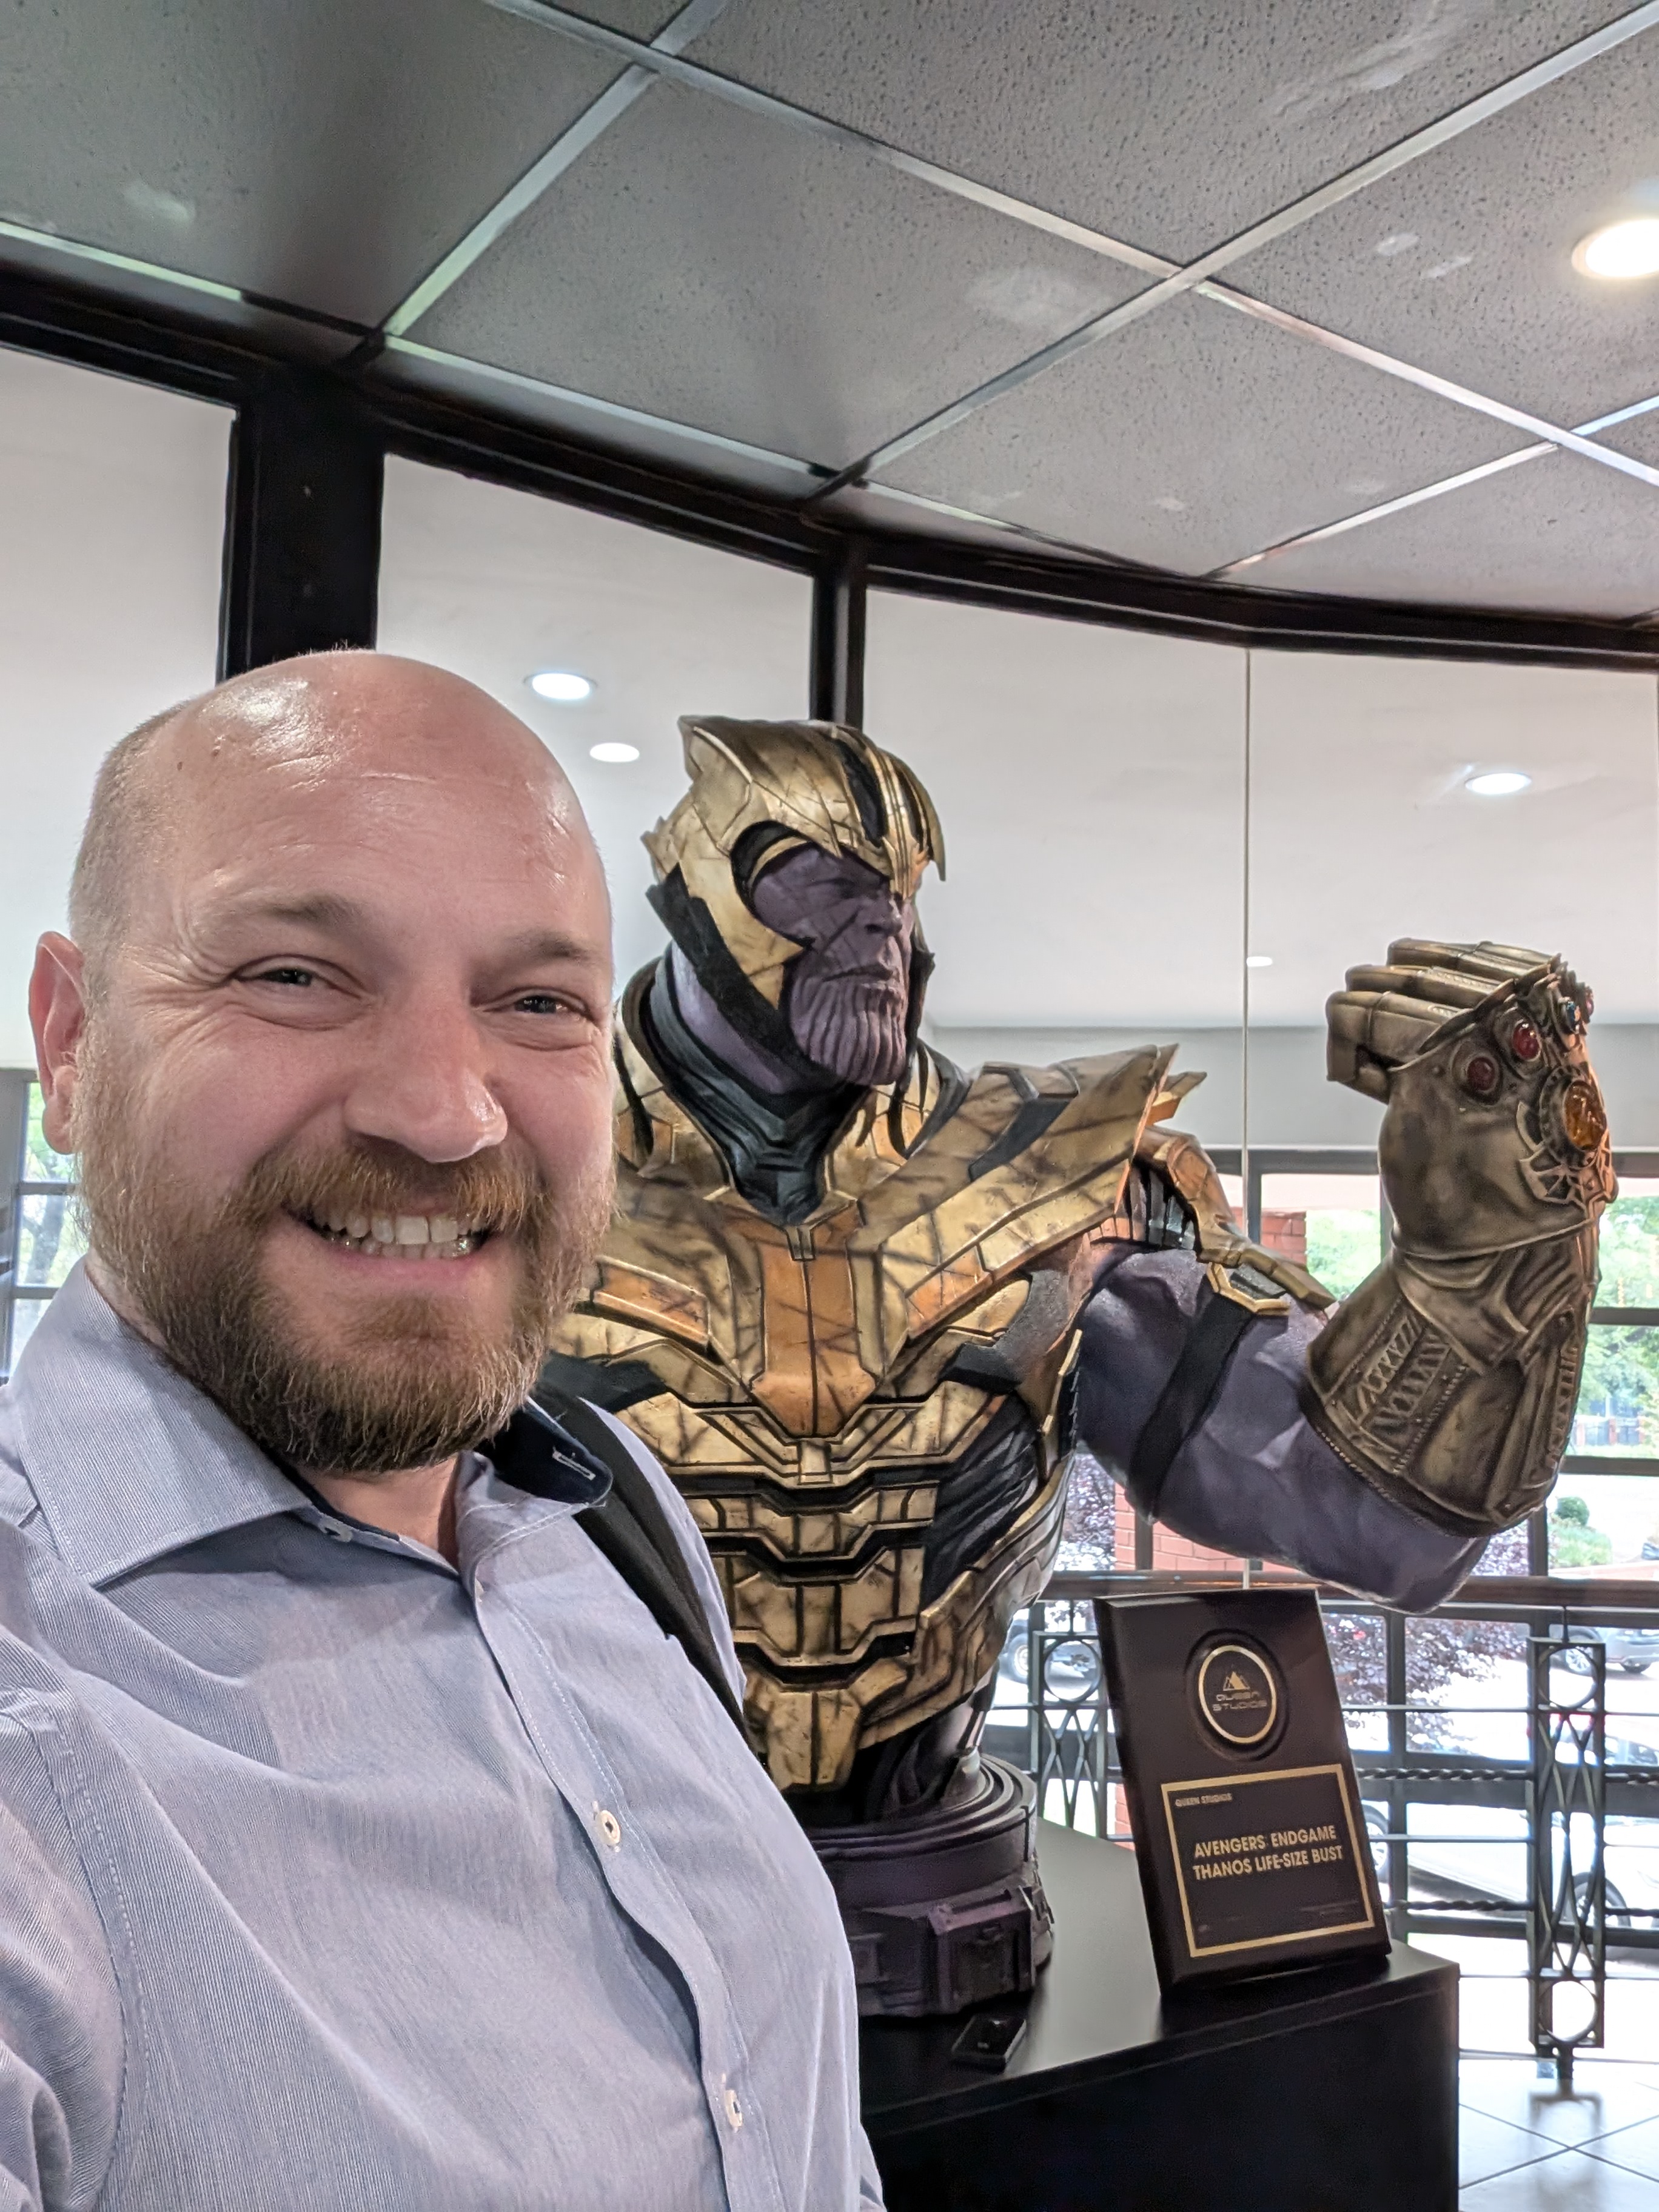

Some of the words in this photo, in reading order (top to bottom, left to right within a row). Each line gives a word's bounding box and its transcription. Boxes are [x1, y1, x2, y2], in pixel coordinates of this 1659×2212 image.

[1270, 1825, 1336, 1848] ENDGAME
[1193, 1857, 1253, 1880] THANOS
[1255, 1850, 1309, 1872] LIFE-SIZE
[1312, 1845, 1343, 1863] BUST
